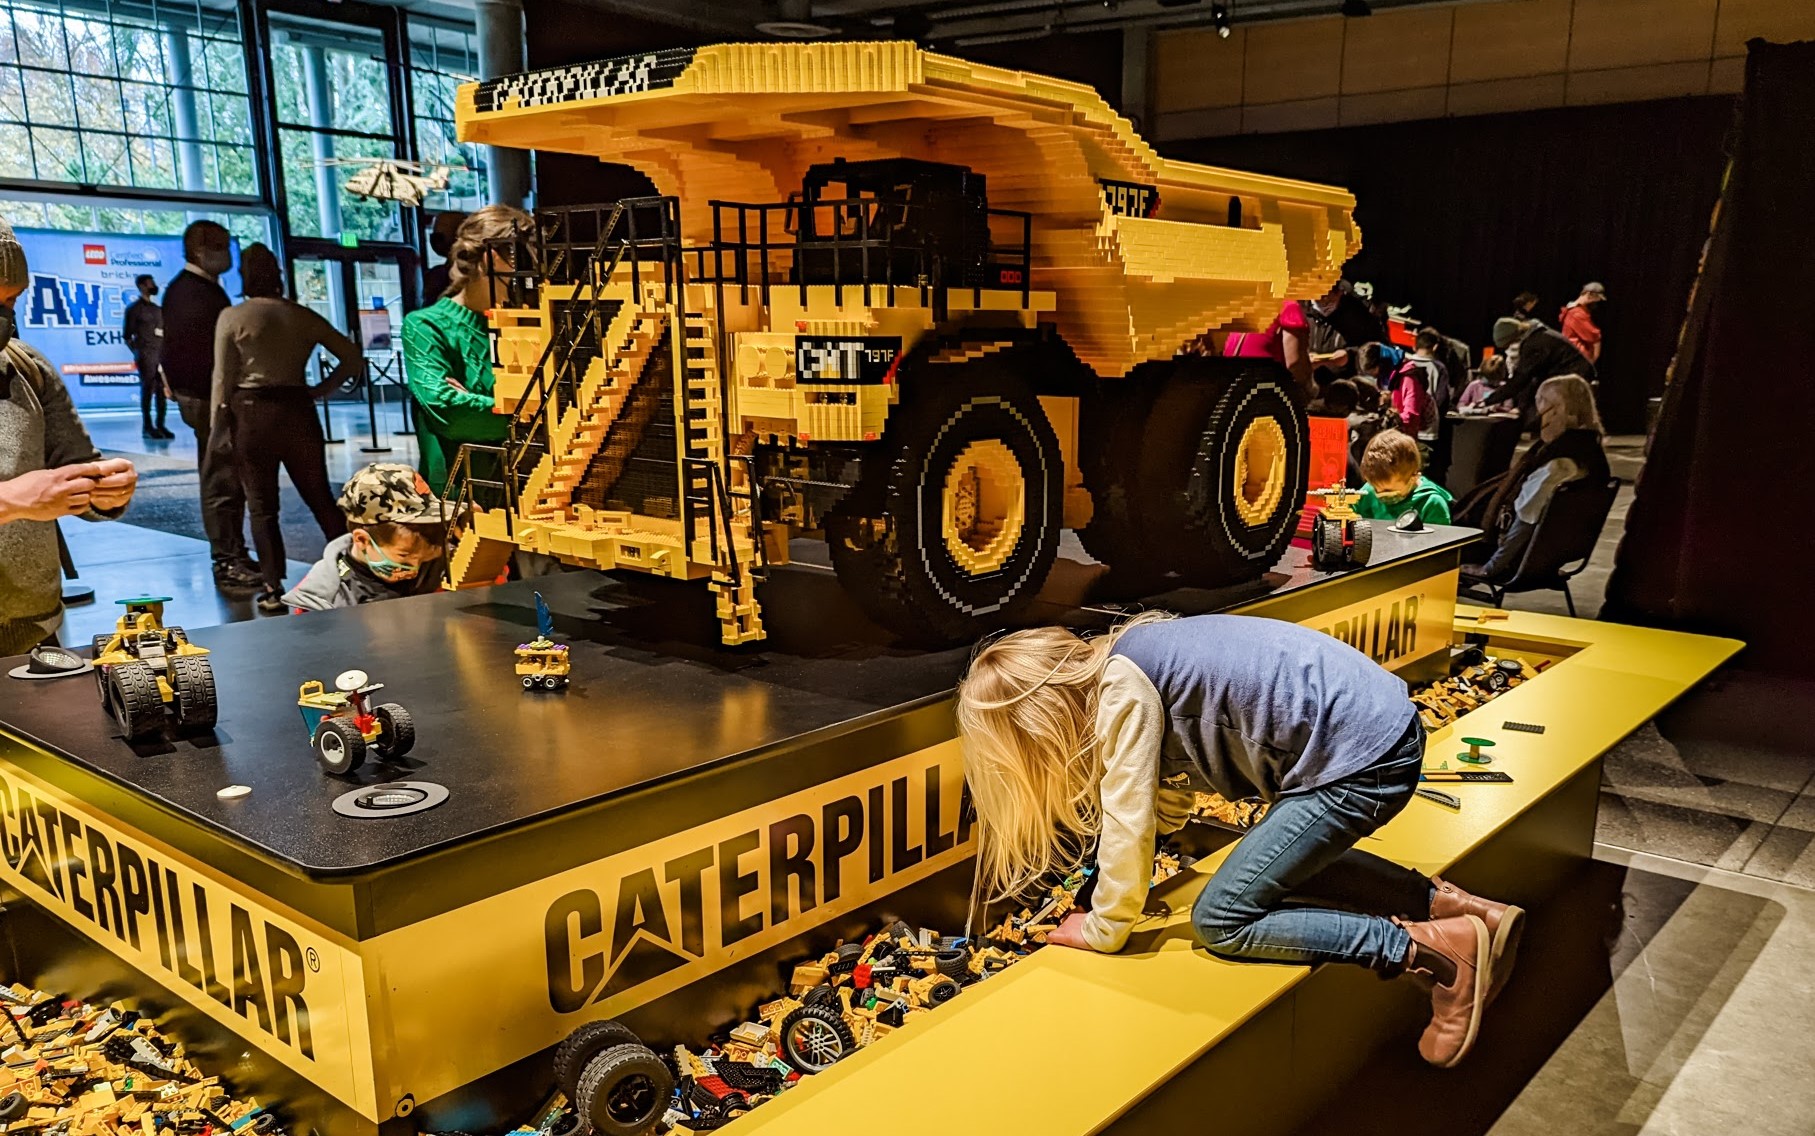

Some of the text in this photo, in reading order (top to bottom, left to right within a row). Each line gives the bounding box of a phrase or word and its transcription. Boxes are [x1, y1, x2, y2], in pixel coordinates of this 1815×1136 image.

[1106, 185, 1149, 218] 797F
[85, 249, 105, 259] LEGO
[110, 258, 162, 267] Professional
[798, 341, 894, 379] CAT 797F
[0, 774, 316, 1062] CATERPILLAR
